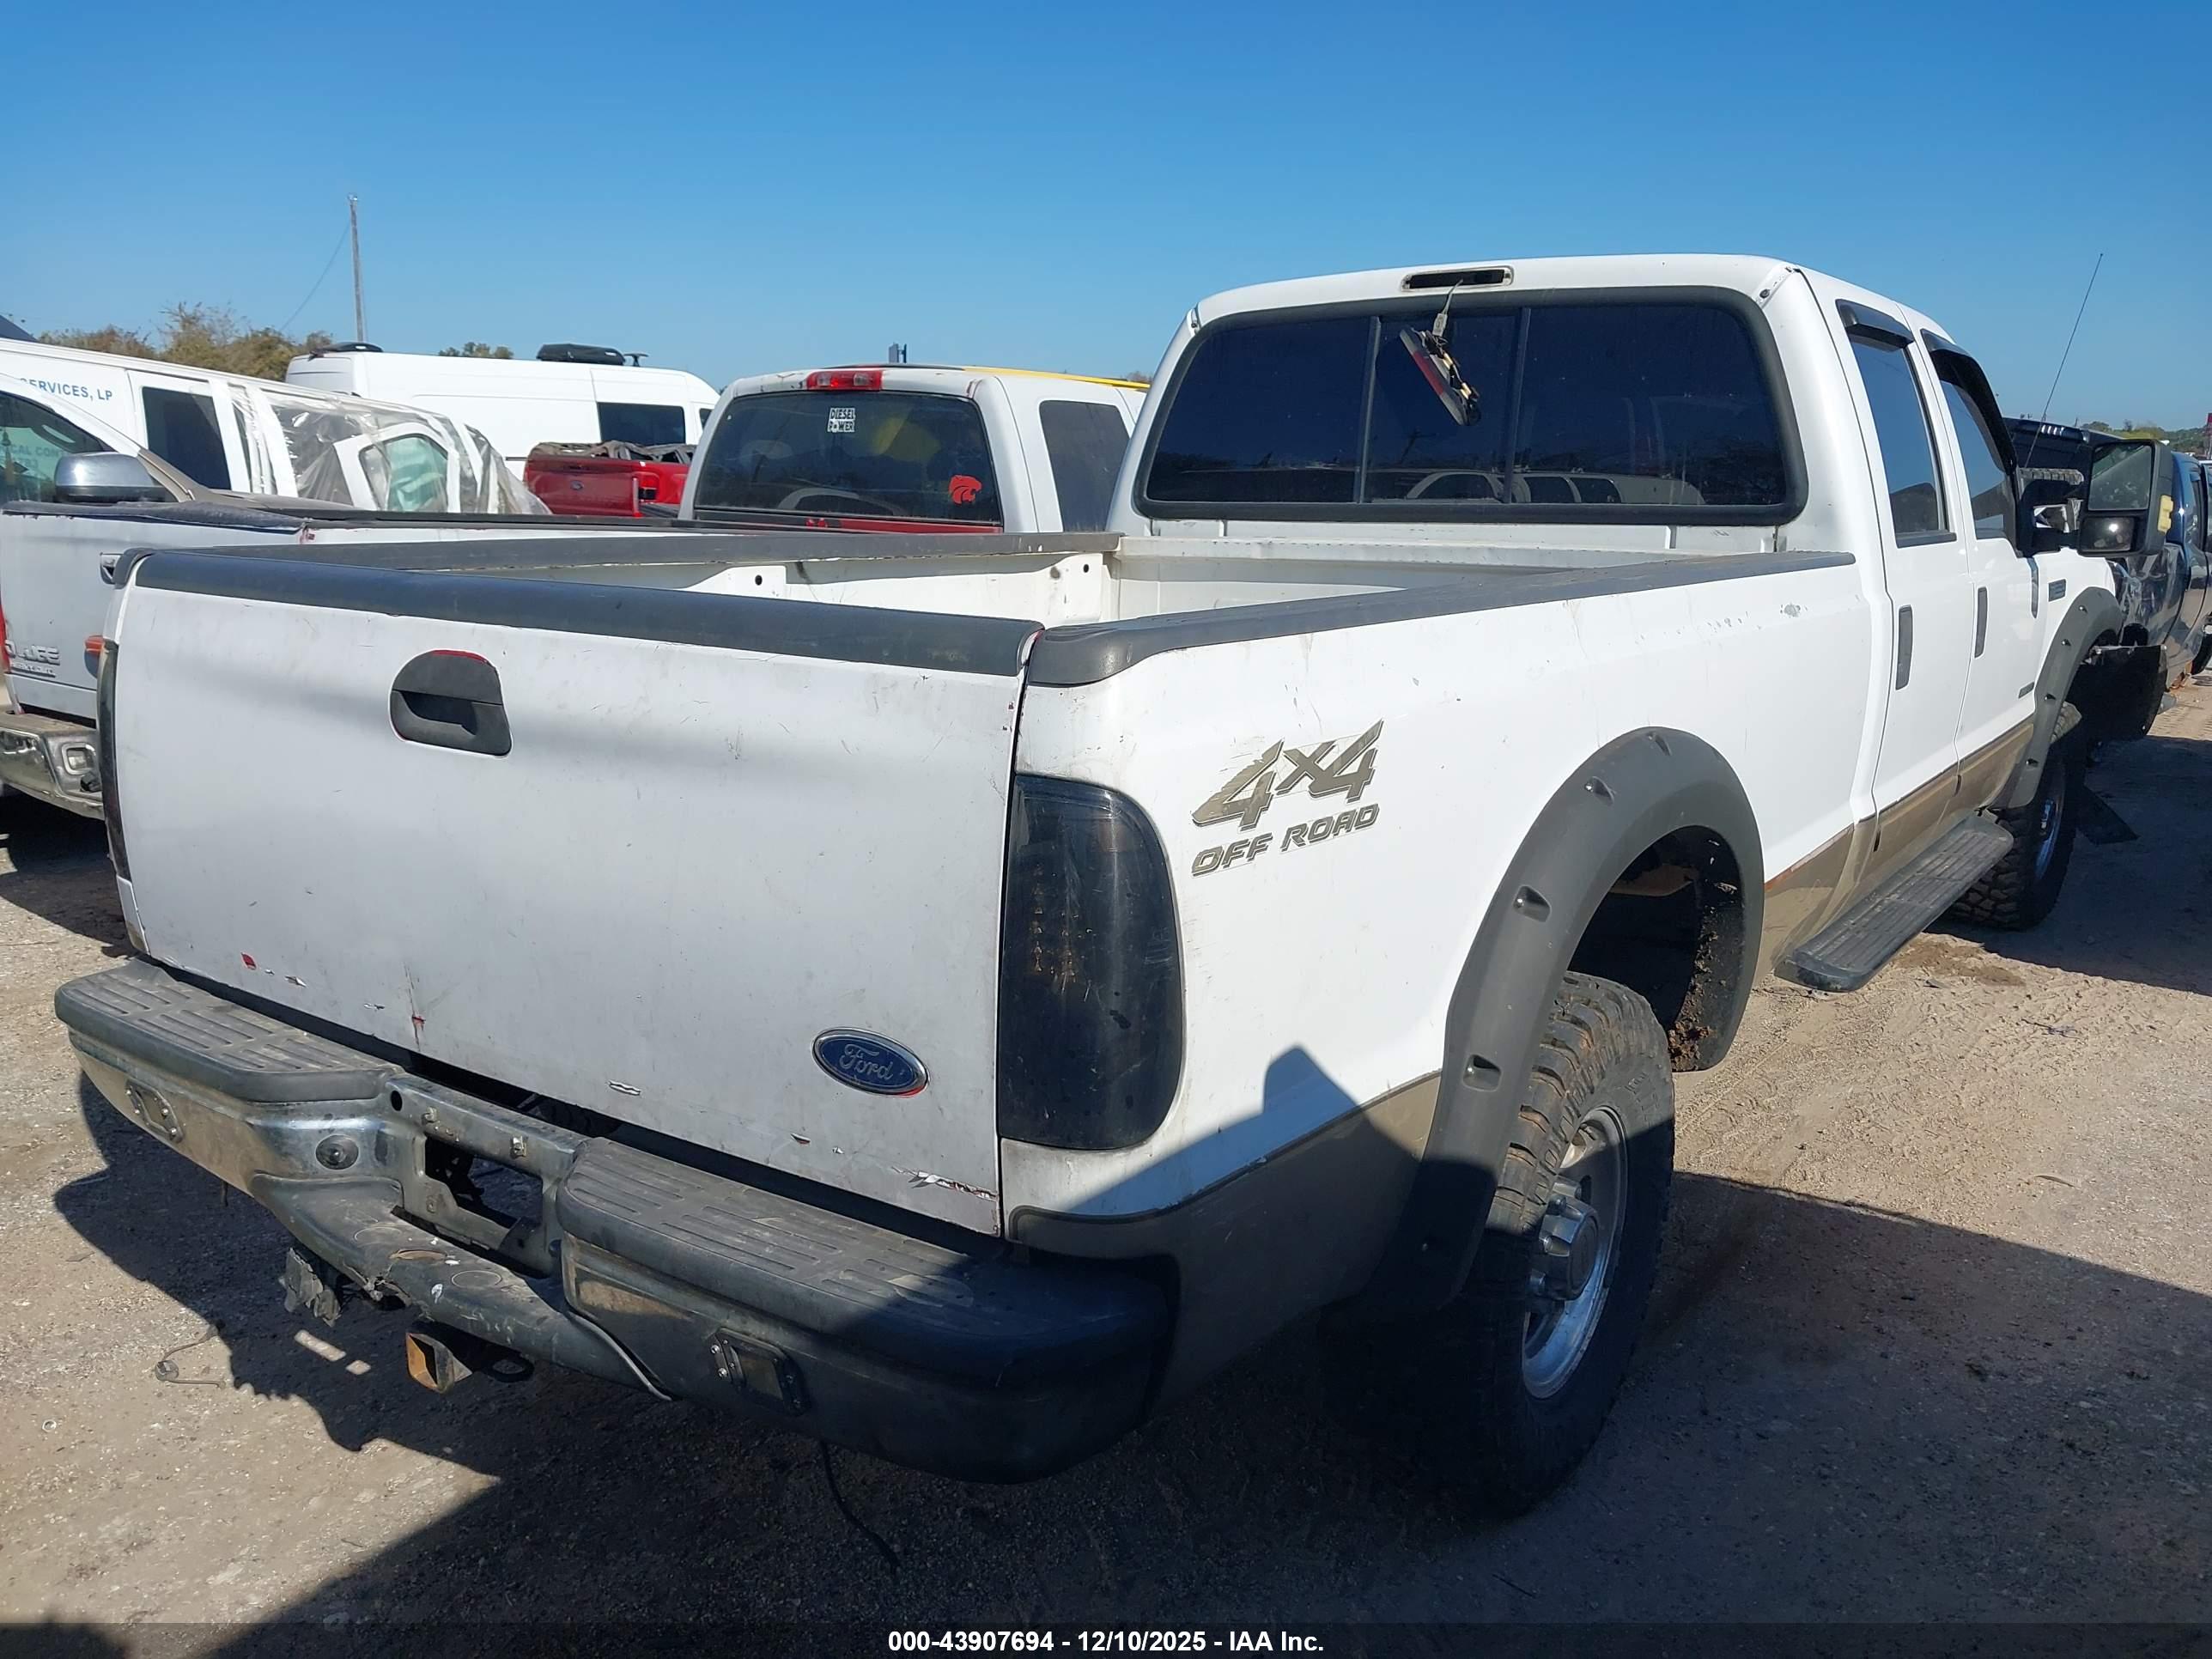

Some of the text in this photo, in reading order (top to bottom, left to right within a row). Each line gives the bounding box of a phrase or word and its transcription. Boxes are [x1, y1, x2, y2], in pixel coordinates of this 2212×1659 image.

[97, 389, 112, 400] LP
[830, 408, 855, 419] DIESEL
[1191, 803, 1380, 877] OFF ROAD
[839, 1043, 894, 1080] Ford
